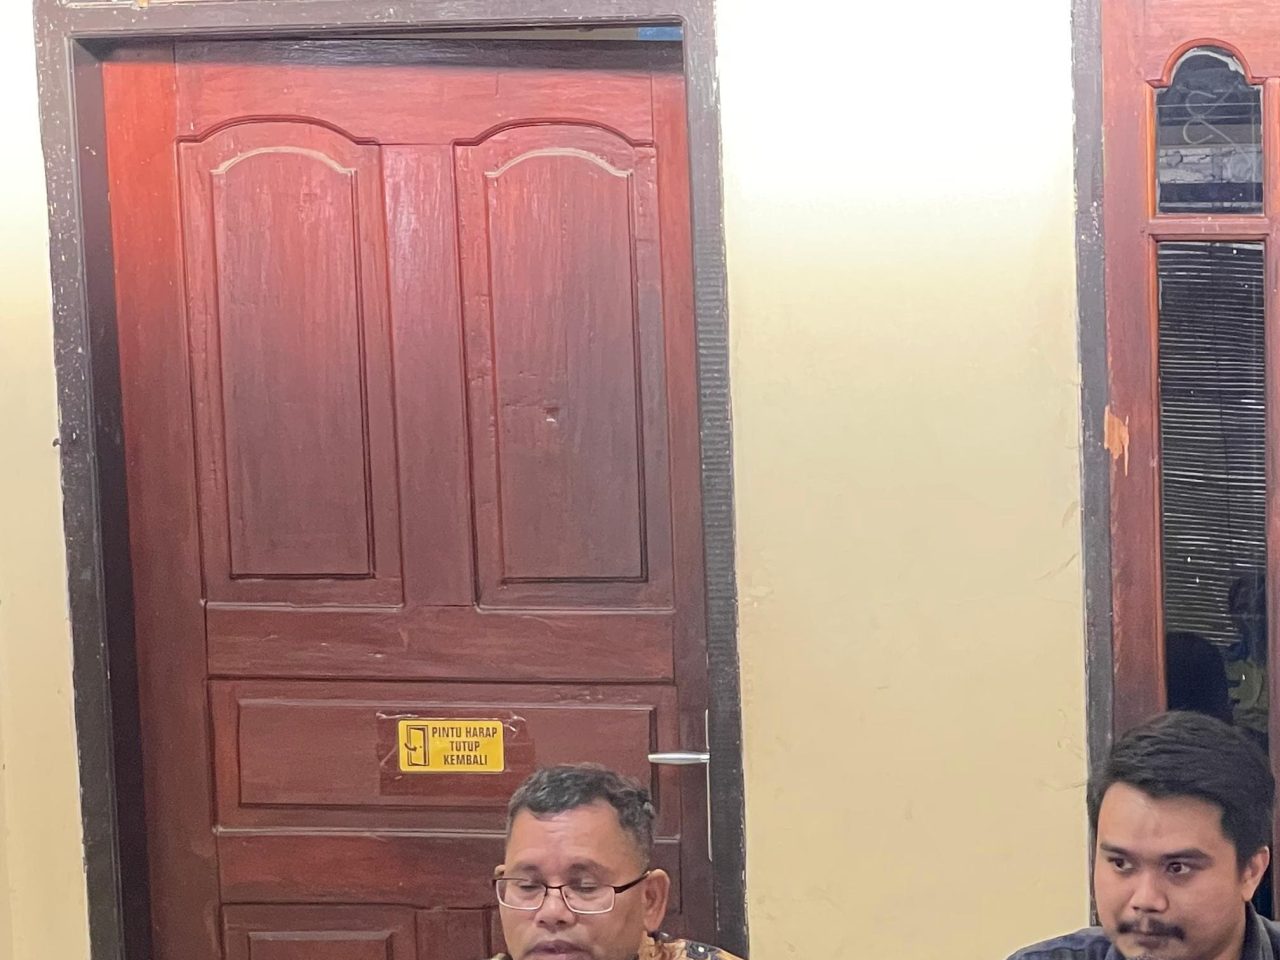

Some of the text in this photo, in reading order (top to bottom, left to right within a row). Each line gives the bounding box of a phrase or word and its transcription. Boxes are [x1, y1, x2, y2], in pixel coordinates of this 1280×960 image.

[431, 726, 498, 738] PINTU HARAP
[449, 740, 481, 752] TUTUP
[443, 754, 488, 766] KEMBALI
